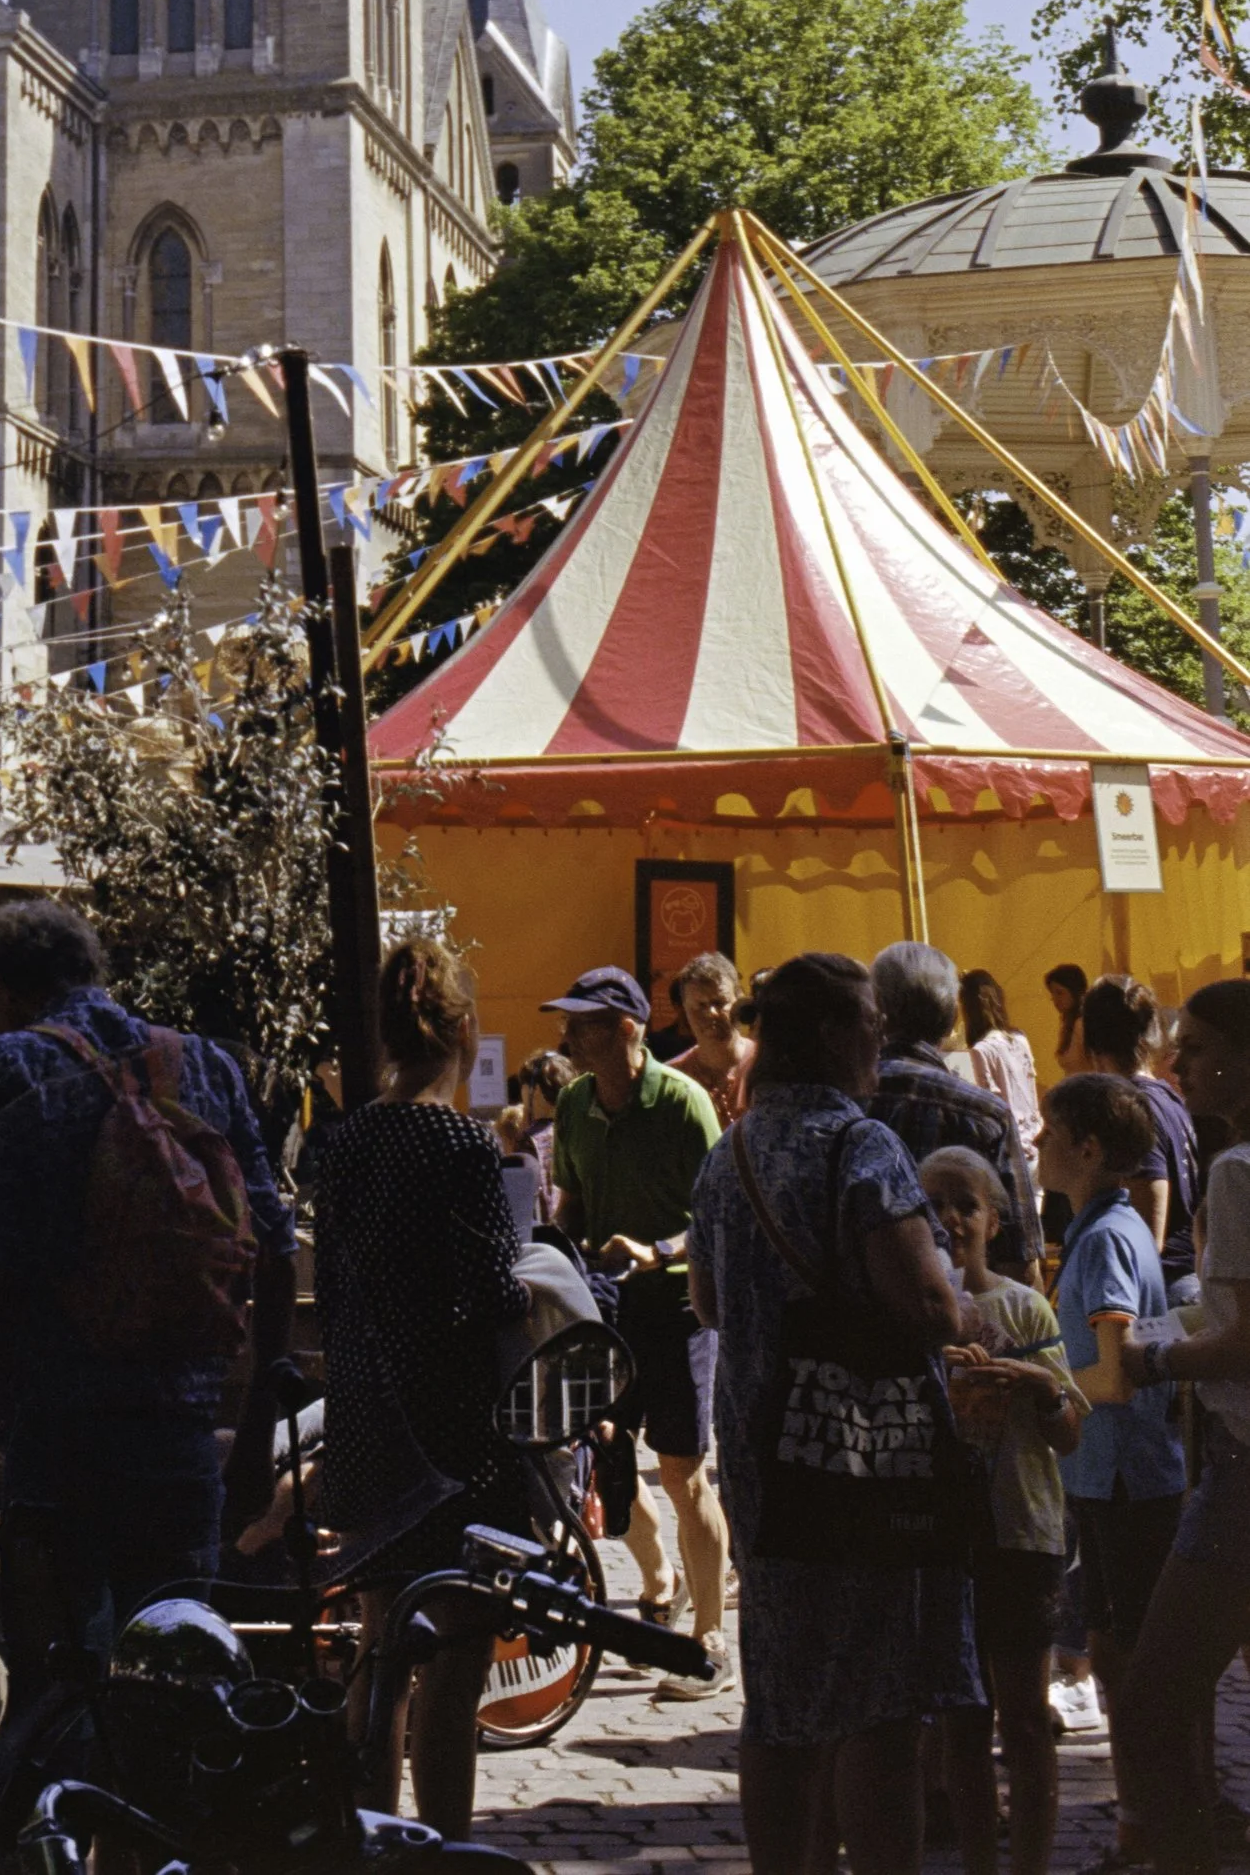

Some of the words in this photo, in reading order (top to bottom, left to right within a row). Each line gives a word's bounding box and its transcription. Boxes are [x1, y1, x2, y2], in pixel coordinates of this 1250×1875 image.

[787, 1357, 927, 1405] TODAY
[783, 1411, 824, 1440] MY
[787, 1386, 803, 1409] I
[812, 1389, 934, 1429] WEAR
[777, 1435, 934, 1478] HAIR
